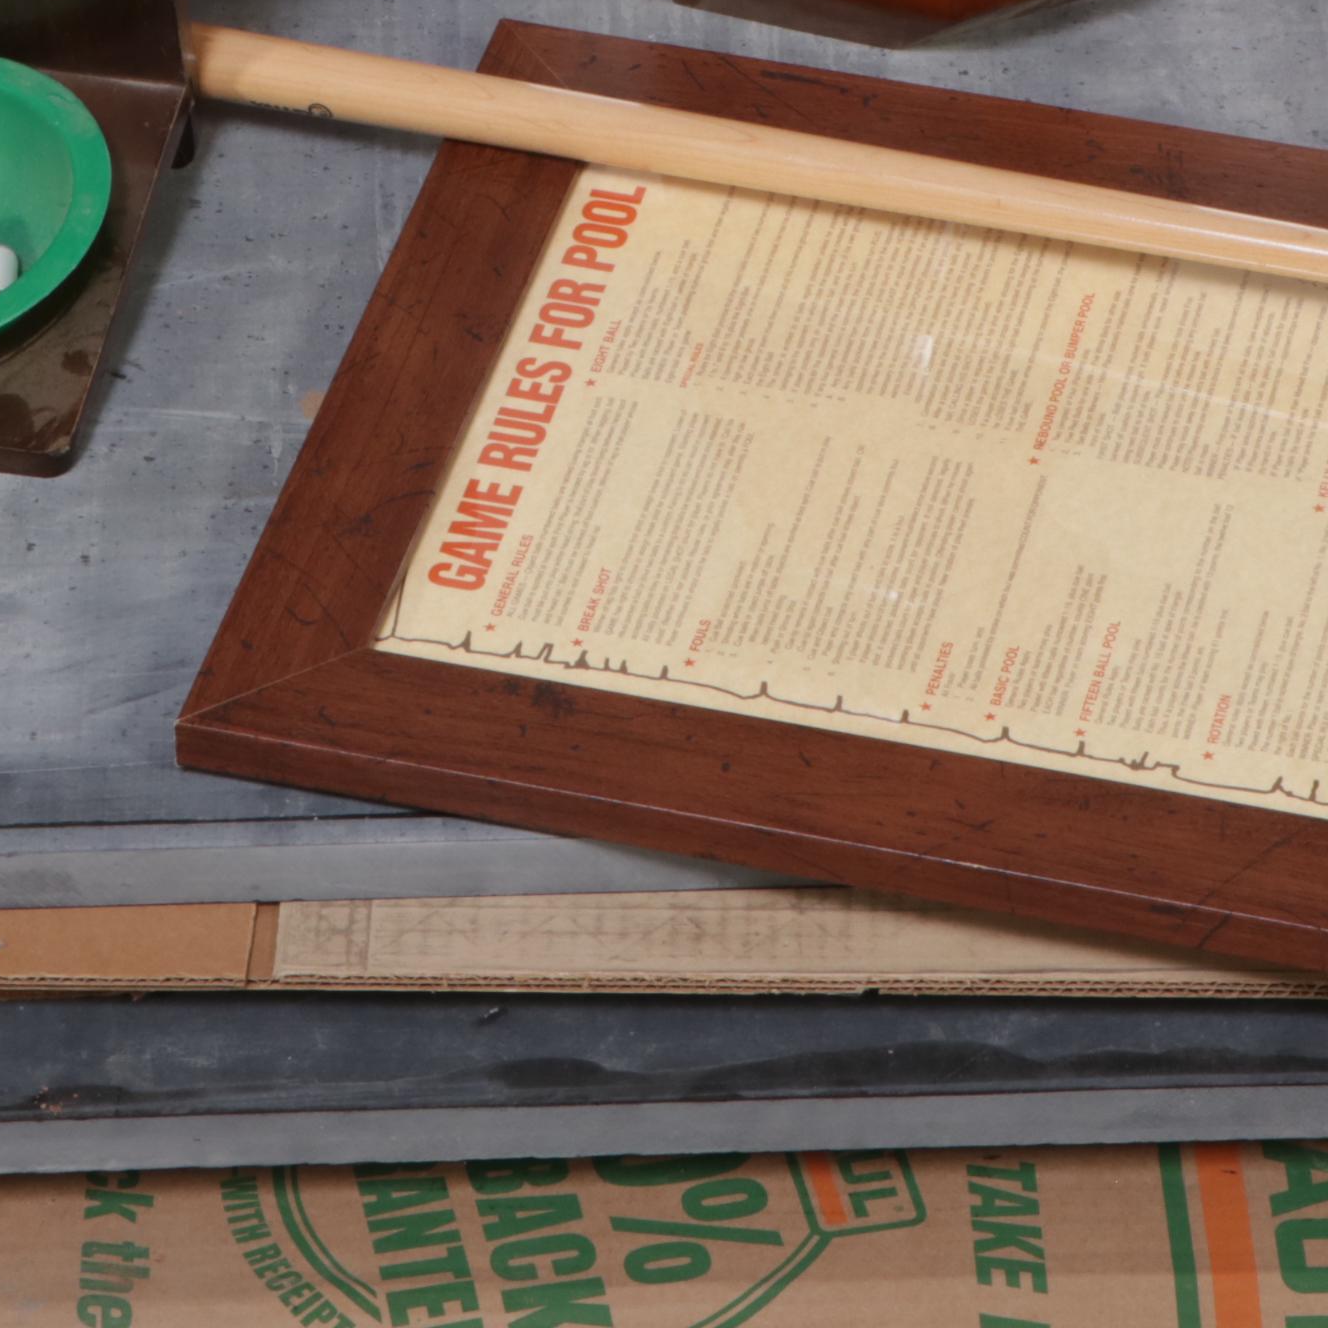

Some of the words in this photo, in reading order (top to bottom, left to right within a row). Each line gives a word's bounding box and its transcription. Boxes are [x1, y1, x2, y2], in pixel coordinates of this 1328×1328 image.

[561, 185, 647, 272] POOL
[528, 278, 607, 351] FOR
[1079, 291, 1098, 319] POOL
[591, 344, 611, 374] EIGHT
[603, 318, 622, 344] BALL
[1059, 360, 1074, 376] OR
[1064, 319, 1088, 360] BUMPER
[478, 357, 573, 472] RULES
[1049, 375, 1068, 403] POOL
[1032, 403, 1058, 451] REBOUND
[428, 479, 523, 591] GAME
[490, 568, 519, 618] GENERAL
[511, 532, 535, 568] RULES
[577, 596, 601, 633] BREAK
[593, 565, 614, 596] SHOT
[690, 617, 711, 653] FOULS
[926, 640, 954, 697] PENALTIES
[990, 675, 1009, 707] BASIC
[1002, 643, 1020, 674] POOL
[1079, 679, 1102, 723] FIFTEEN
[1094, 651, 1111, 678] BALL
[1103, 619, 1121, 650] POOL
[1207, 692, 1231, 745] ROTATION
[354, 1161, 484, 1328] ANTE
[967, 1162, 1048, 1294] TAKE
[77, 1241, 151, 1328] the
